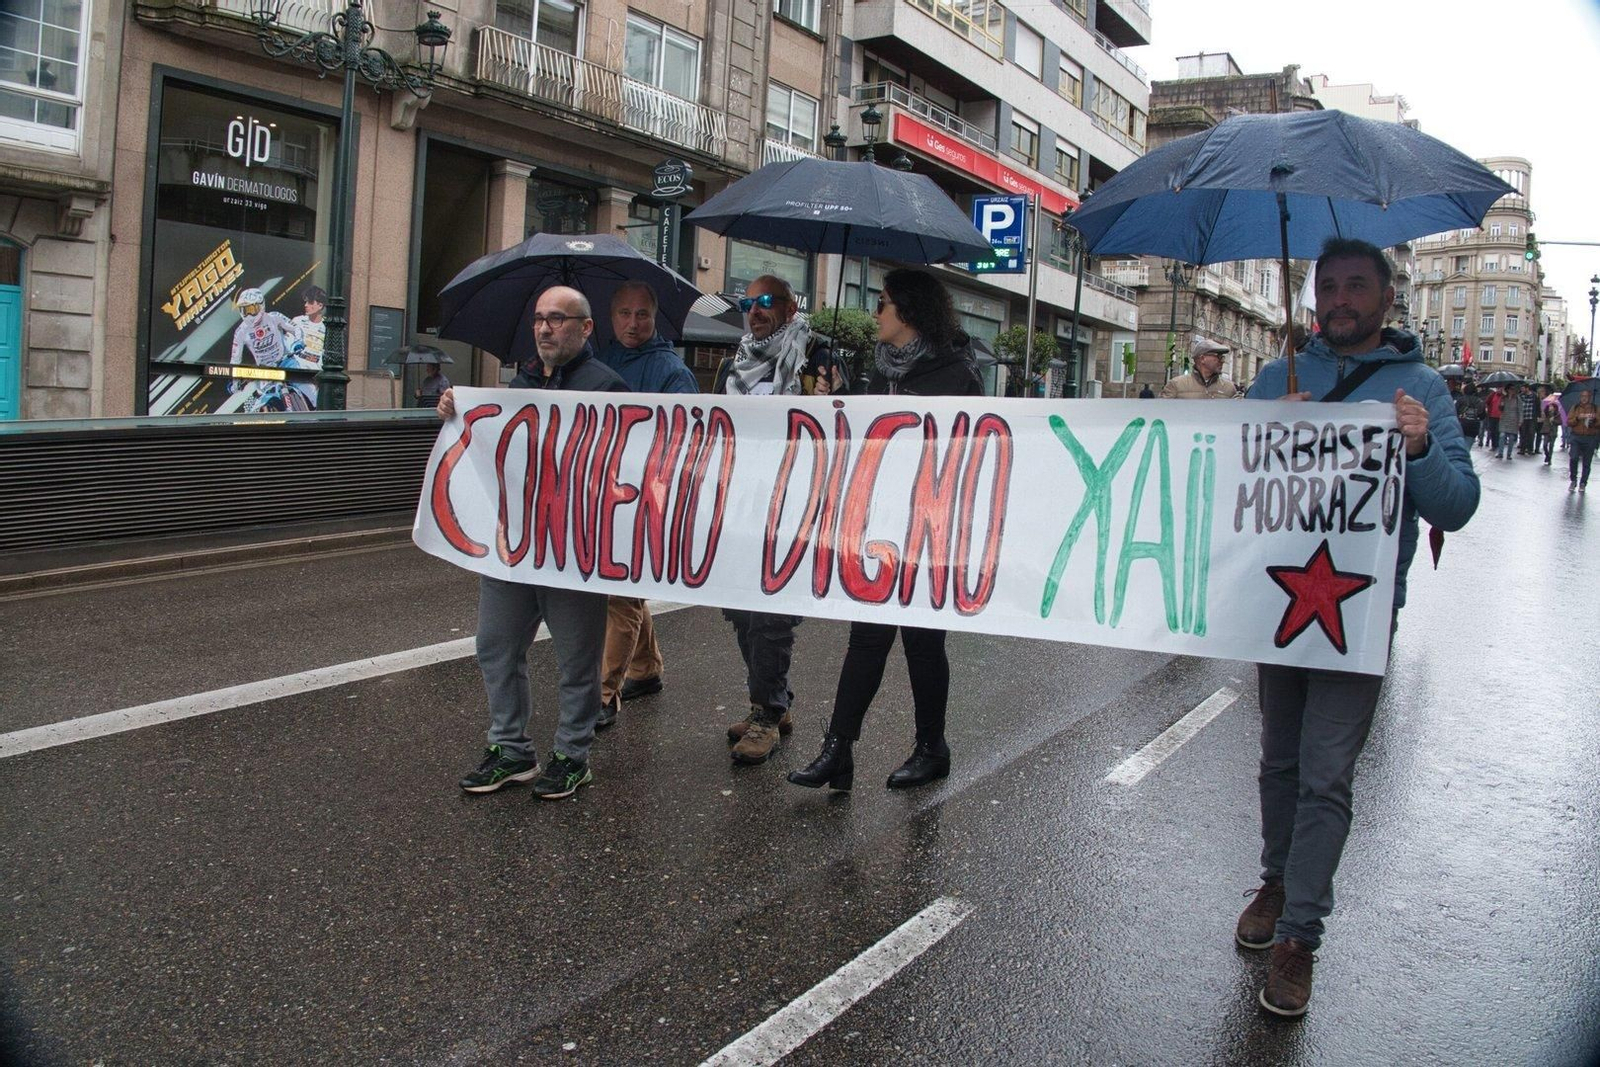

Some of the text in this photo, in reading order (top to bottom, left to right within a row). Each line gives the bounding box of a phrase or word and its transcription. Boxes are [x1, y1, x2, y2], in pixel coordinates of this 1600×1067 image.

[946, 147, 966, 163] seguros
[193, 170, 297, 202] GAVÍN DERMATOLOGOS
[656, 174, 681, 184] ECOS
[786, 200, 823, 210] PROFILTER
[982, 204, 1015, 244] P
[161, 247, 236, 319] YAGO
[1241, 421, 1404, 475] URBASER
[1233, 473, 1402, 535] MORRAZO
